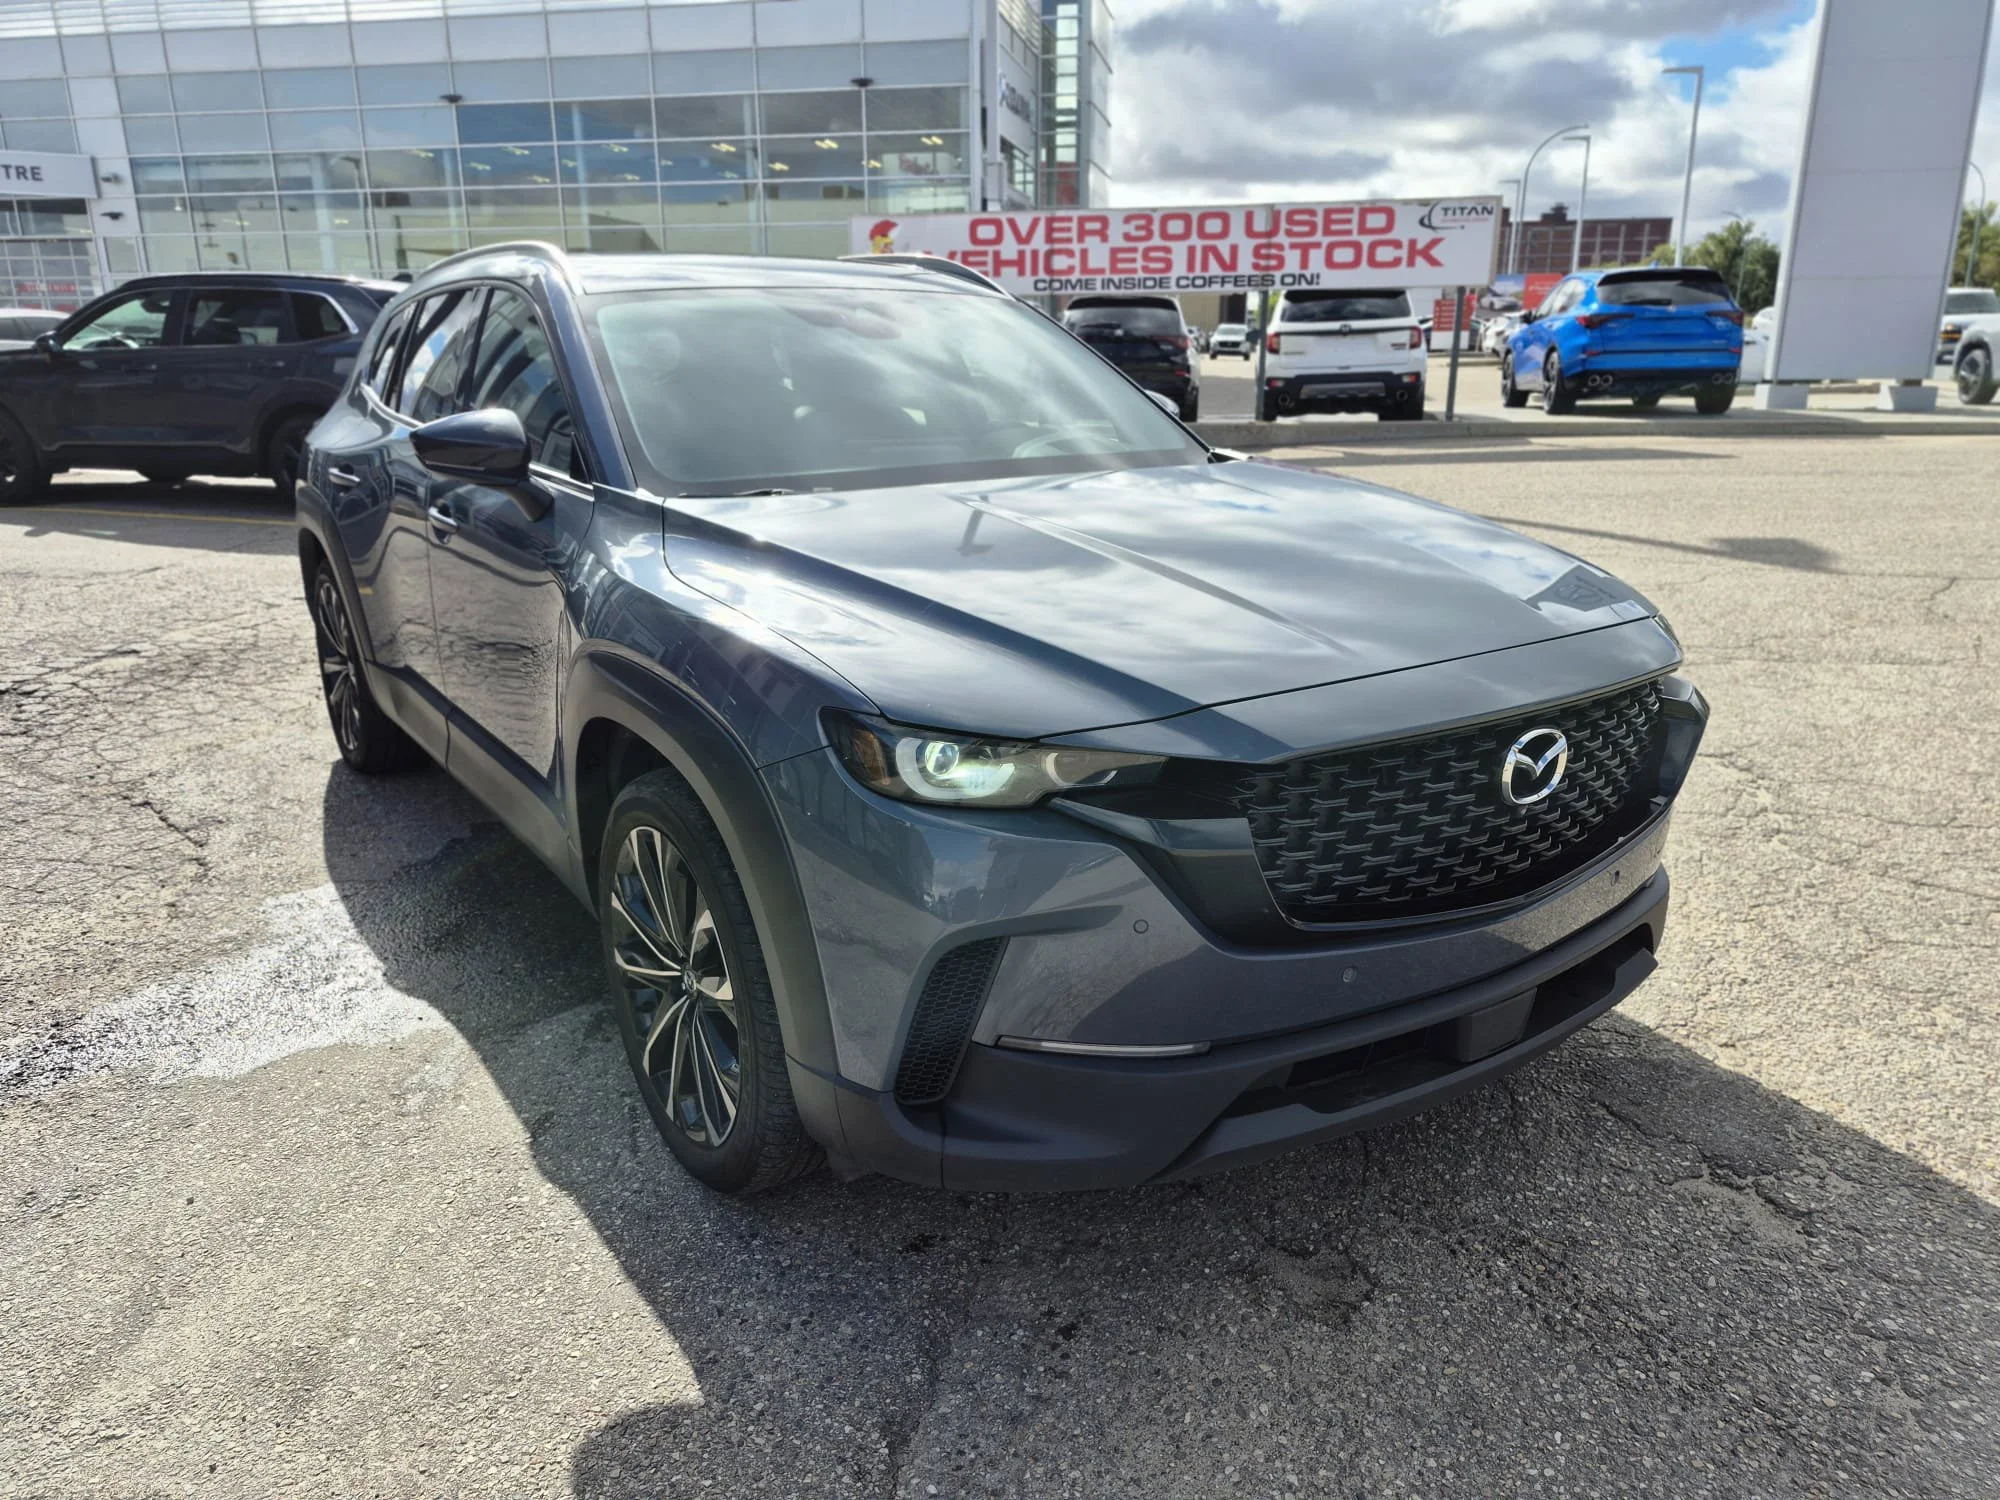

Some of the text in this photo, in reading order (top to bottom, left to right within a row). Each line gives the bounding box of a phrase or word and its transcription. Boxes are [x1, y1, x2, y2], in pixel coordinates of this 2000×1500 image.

[969, 205, 1396, 246] OVER 300 USED
[1441, 206, 1494, 217] TITAN
[1186, 243, 1239, 273] IN
[1251, 237, 1446, 272] STOCK
[1033, 272, 1321, 292] COME INSIDE COFFEES ON!
